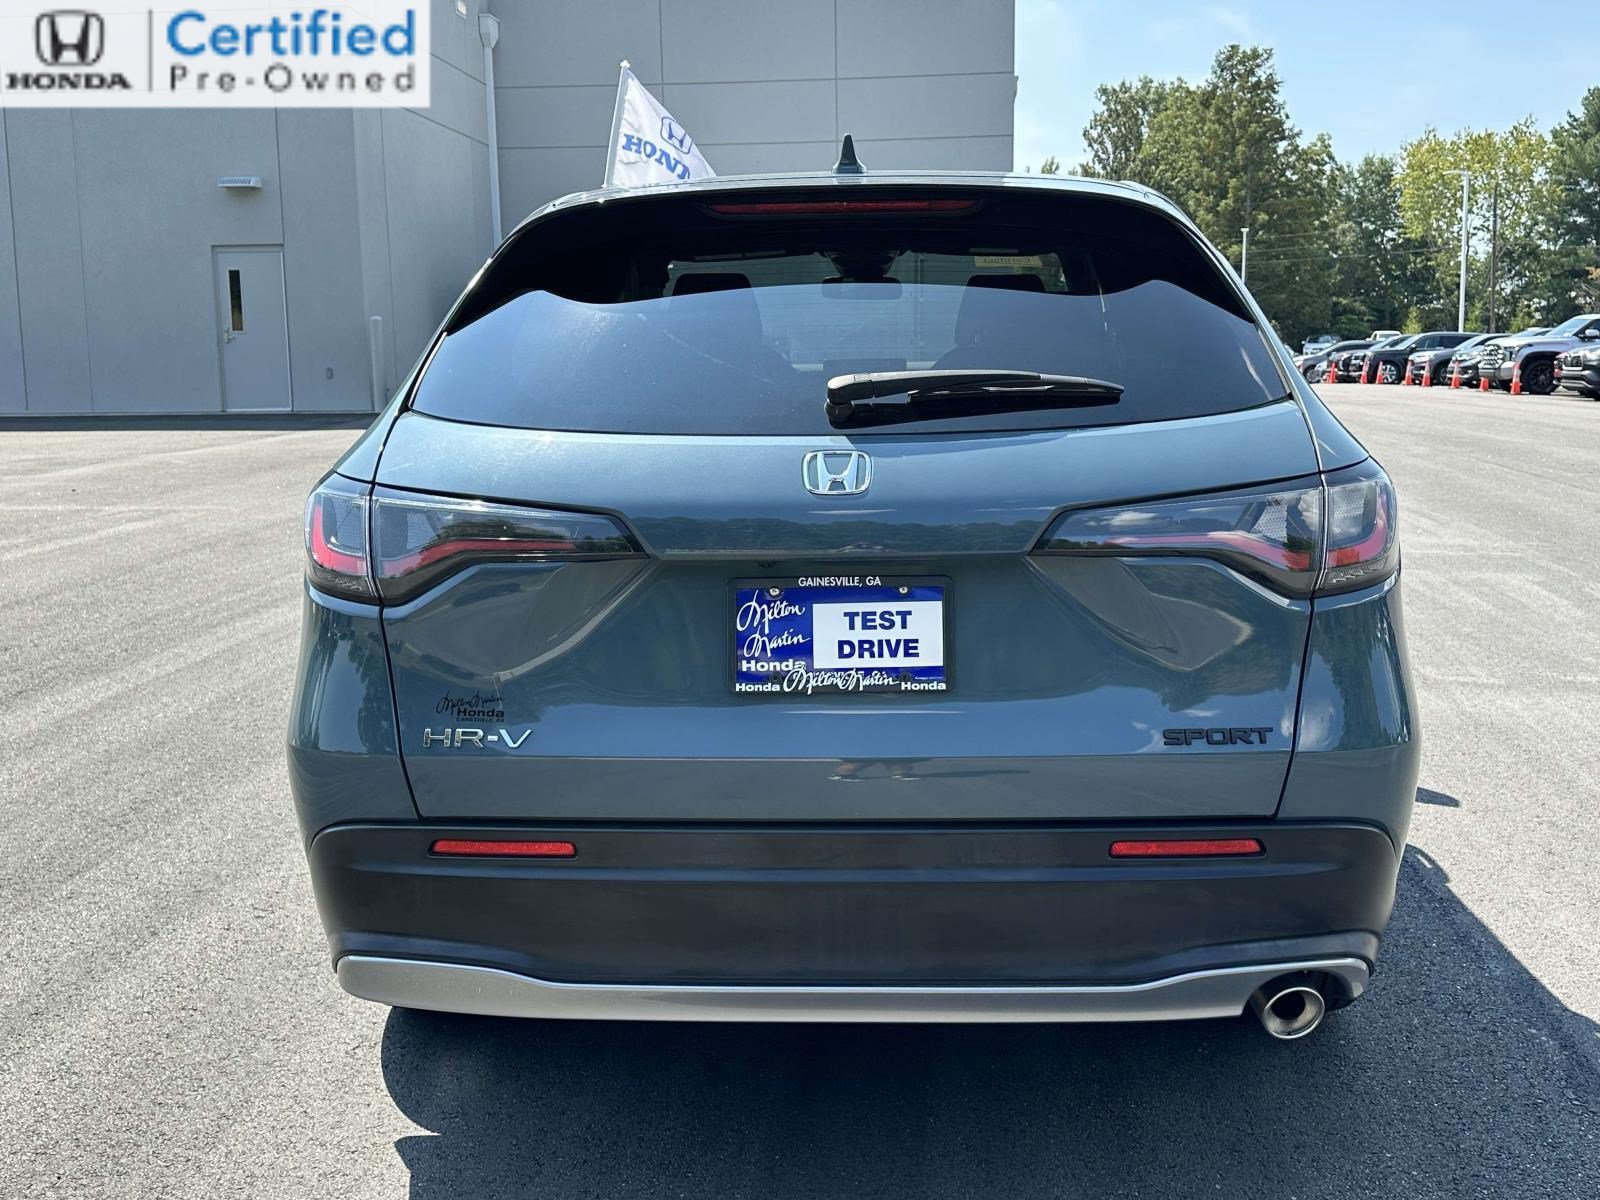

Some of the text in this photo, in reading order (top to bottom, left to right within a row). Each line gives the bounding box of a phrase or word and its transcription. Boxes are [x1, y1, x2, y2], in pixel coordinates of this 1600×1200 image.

[798, 576, 881, 587] GAINESVILLE, GA
[736, 589, 805, 634] Milton
[843, 610, 912, 631] TEST
[743, 625, 812, 657] Martin
[837, 638, 919, 659] DRIVE
[741, 659, 806, 672] Honda
[735, 682, 780, 692] Honda
[782, 663, 900, 695] Milton Martin
[901, 681, 946, 691] Honda
[456, 708, 504, 717] Honda
[423, 728, 532, 748] HR-V
[1162, 727, 1274, 746] SPORT
